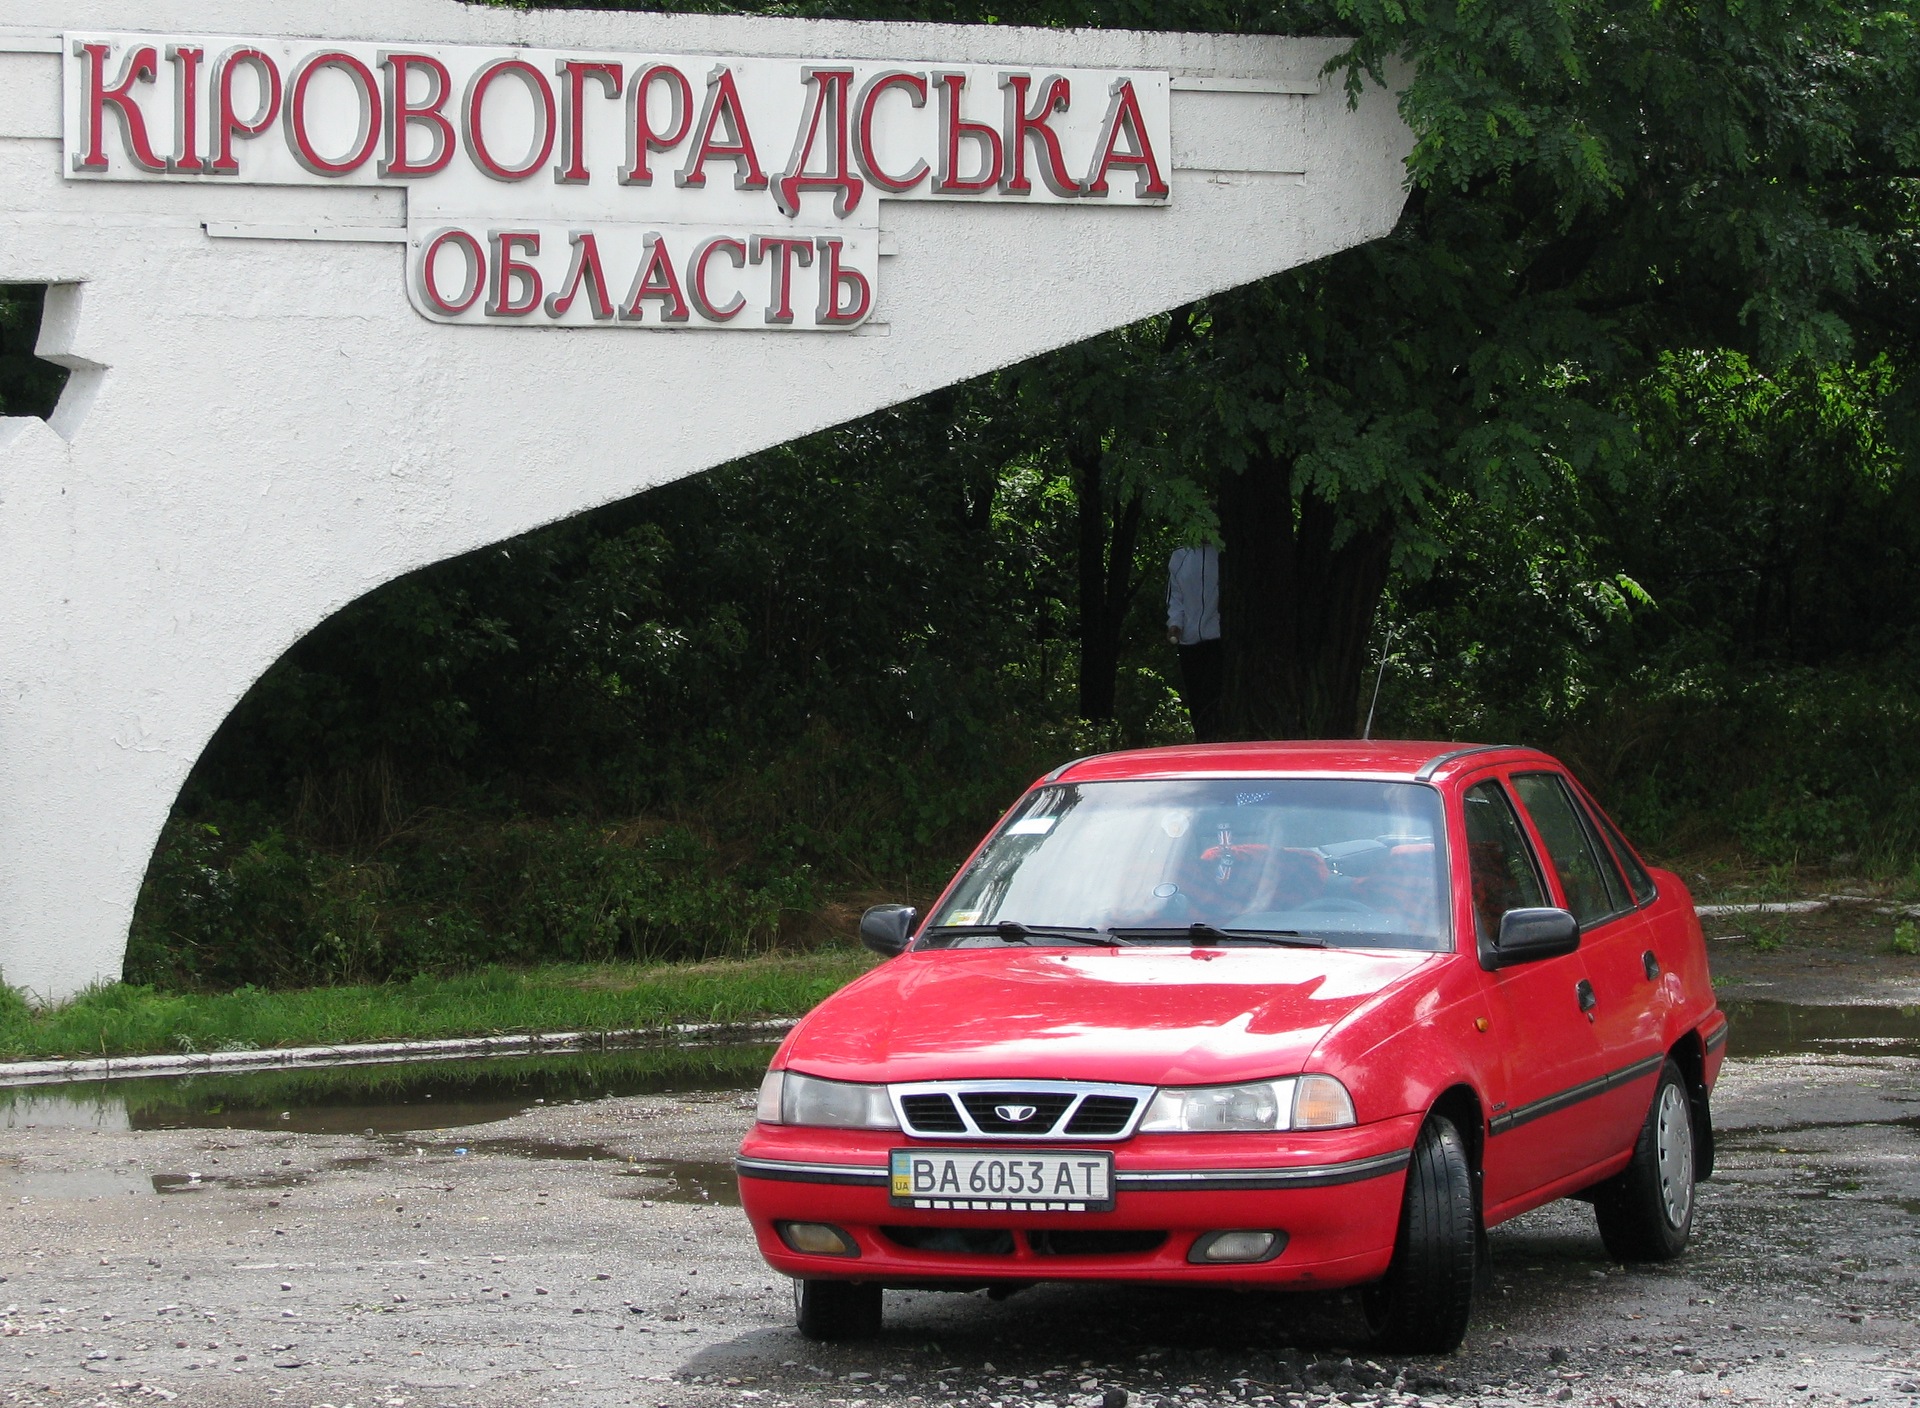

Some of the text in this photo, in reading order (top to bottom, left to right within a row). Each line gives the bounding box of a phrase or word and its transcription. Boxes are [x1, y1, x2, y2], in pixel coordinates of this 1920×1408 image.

[73, 40, 1170, 218] КІРОВОГРАДСЬКА
[415, 227, 871, 324] ОБЛАСТЬ
[895, 1182, 909, 1190] UA
[913, 1160, 1100, 1195] BA 6053 AT
